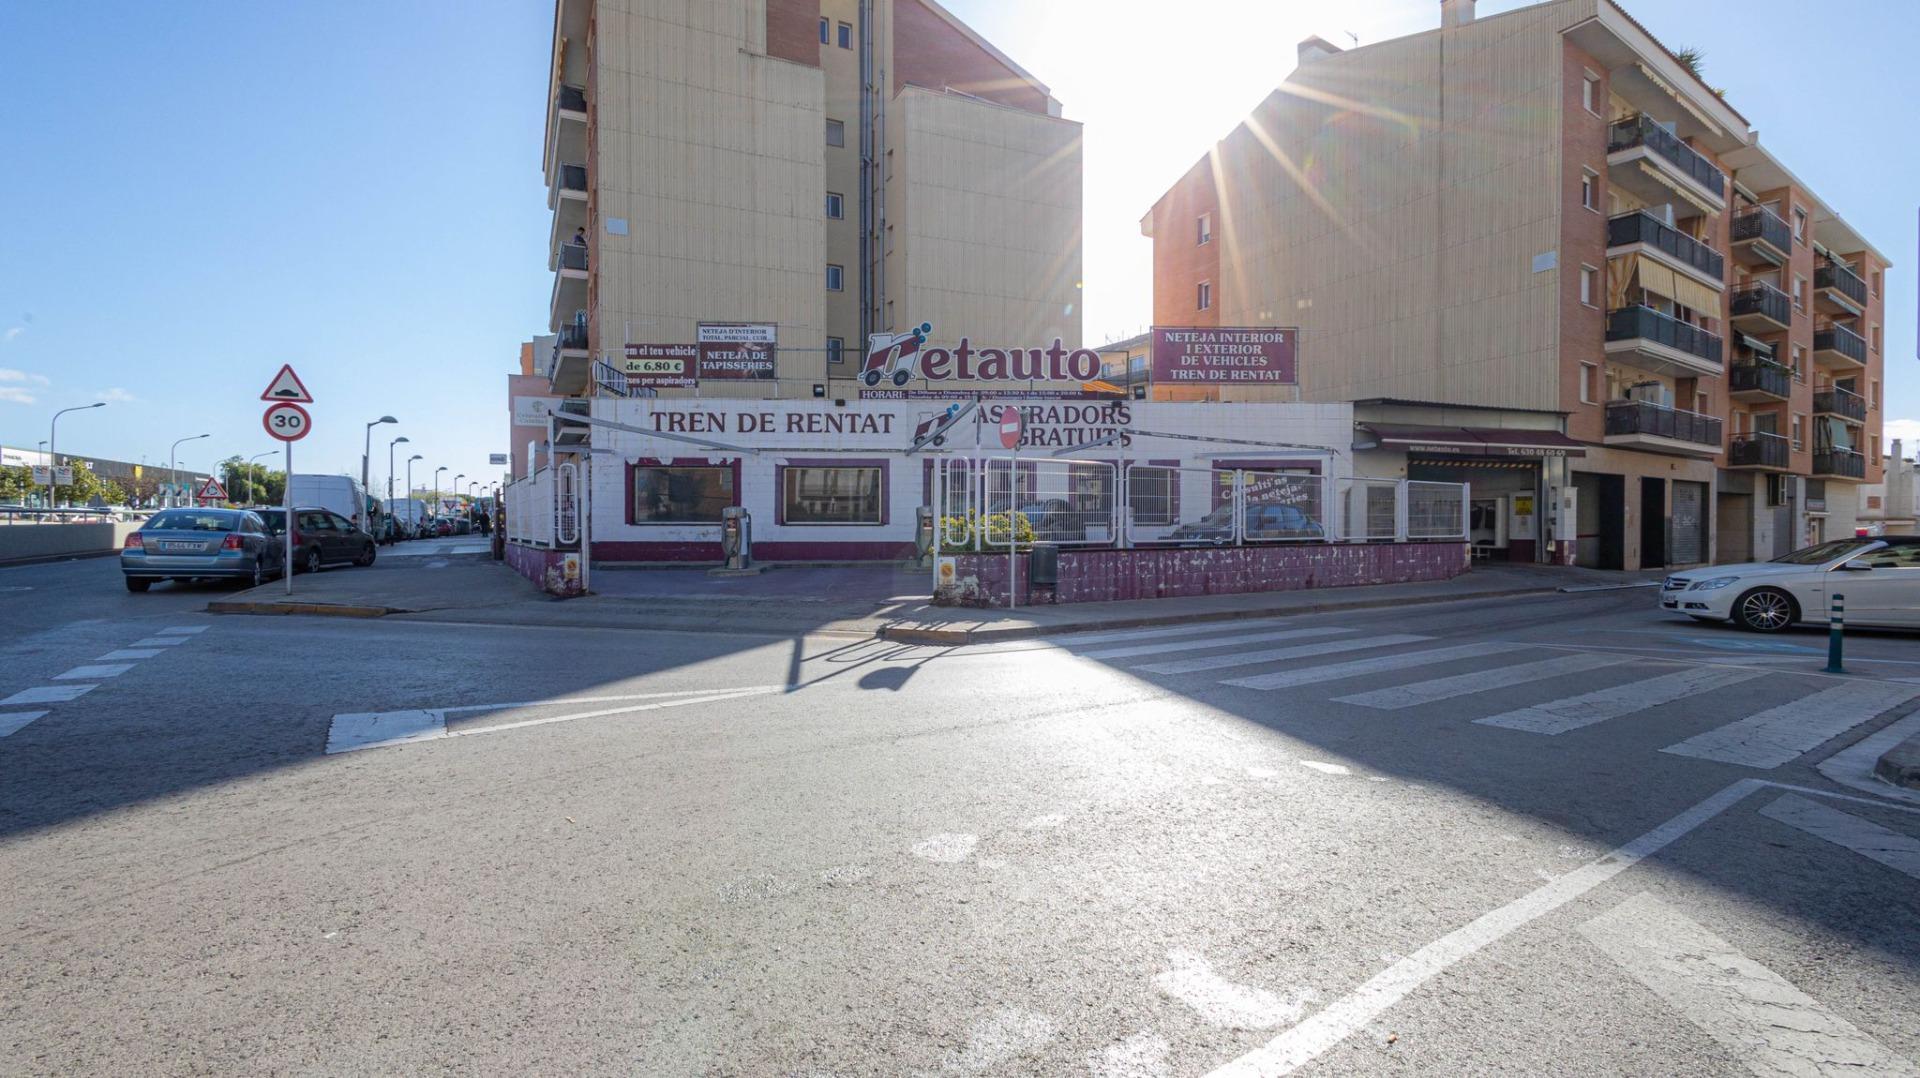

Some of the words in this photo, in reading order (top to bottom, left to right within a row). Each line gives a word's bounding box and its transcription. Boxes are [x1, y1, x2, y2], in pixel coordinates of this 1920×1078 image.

[1165, 332, 1217, 343] NETEJA
[1220, 332, 1284, 344] INTERIOR
[639, 344, 649, 356] el
[650, 346, 664, 356] teu
[665, 344, 697, 356] vehicle
[1185, 344, 1192, 355] I
[1194, 344, 1263, 355] EXTERIOR
[706, 351, 750, 360] NETEJA
[752, 351, 768, 360] DE
[1180, 355, 1201, 366] DE
[1203, 355, 1269, 367] VEHICLES
[626, 361, 641, 372] de
[674, 362, 682, 372] €
[701, 361, 774, 370] TAPISSERIES
[1170, 369, 1206, 380] TREN
[1209, 369, 1228, 380] DE
[1230, 370, 1282, 380] RENTAT
[860, 390, 905, 399] HORARI:
[972, 405, 1131, 425] ASRADORS
[274, 414, 301, 428] 30
[650, 412, 727, 433] TREN
[737, 412, 776, 433] DE
[786, 413, 896, 434] RENTAT
